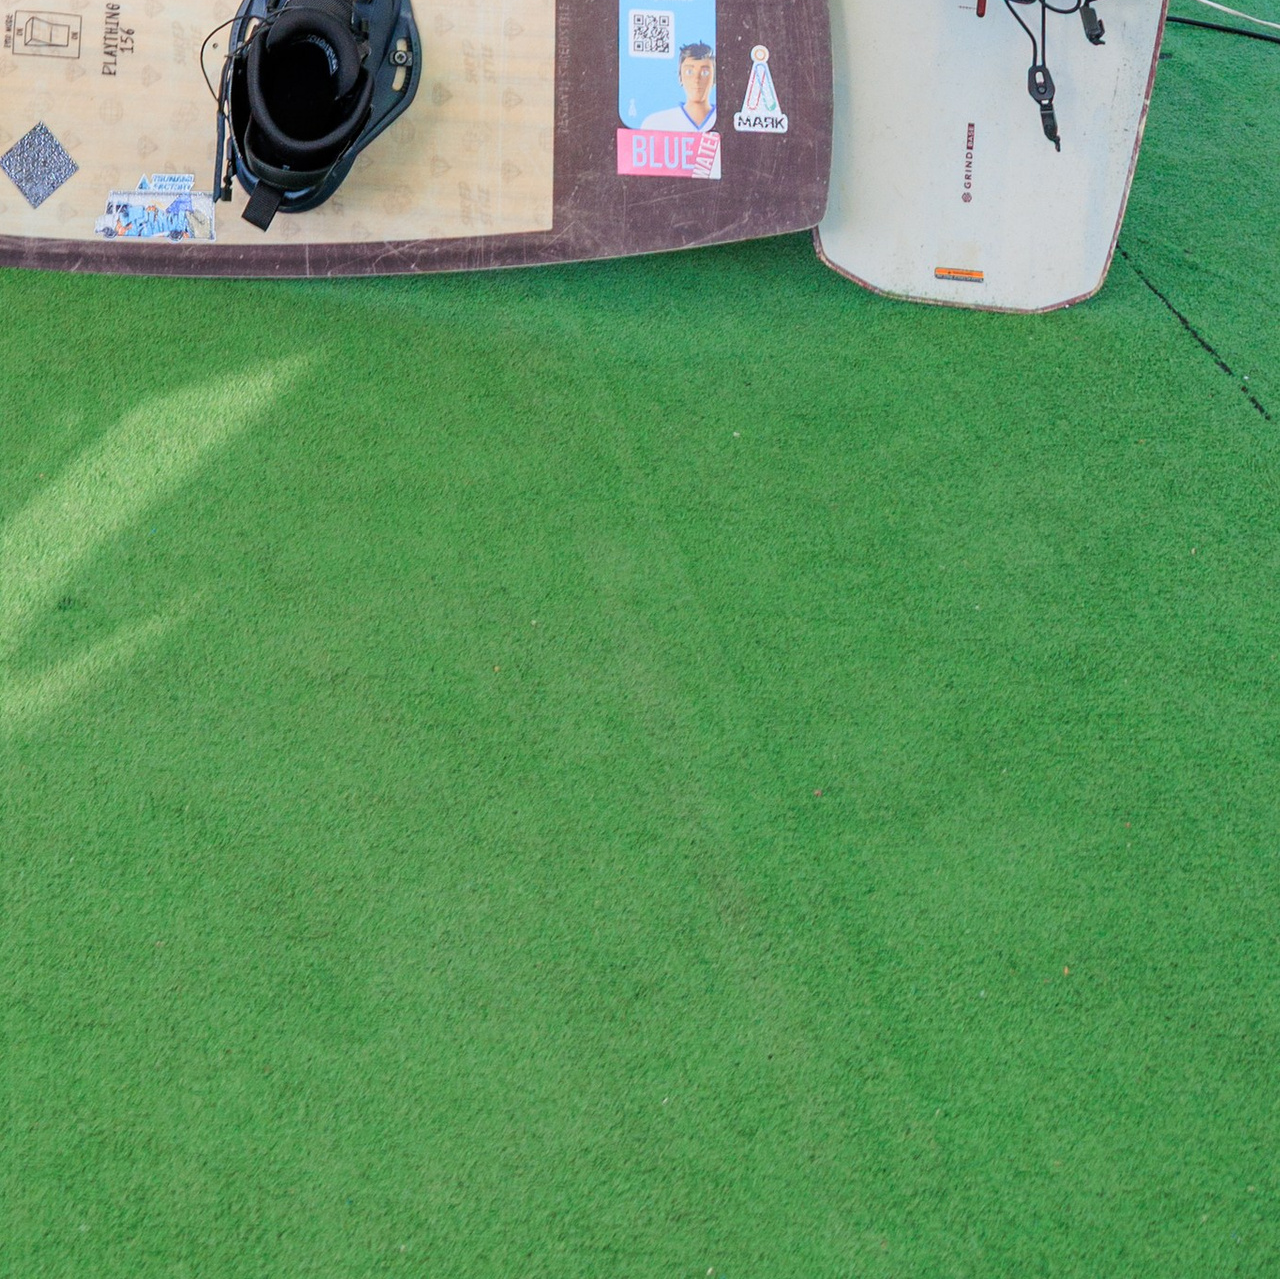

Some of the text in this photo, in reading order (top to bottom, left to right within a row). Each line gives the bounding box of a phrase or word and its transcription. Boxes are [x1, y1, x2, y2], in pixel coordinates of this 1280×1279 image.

[101, 2, 122, 77] PLAYTHING
[120, 27, 136, 54] 156
[737, 114, 786, 130] МАЯК
[632, 135, 696, 170] BLUE
[963, 125, 975, 190] GRIND BASE
